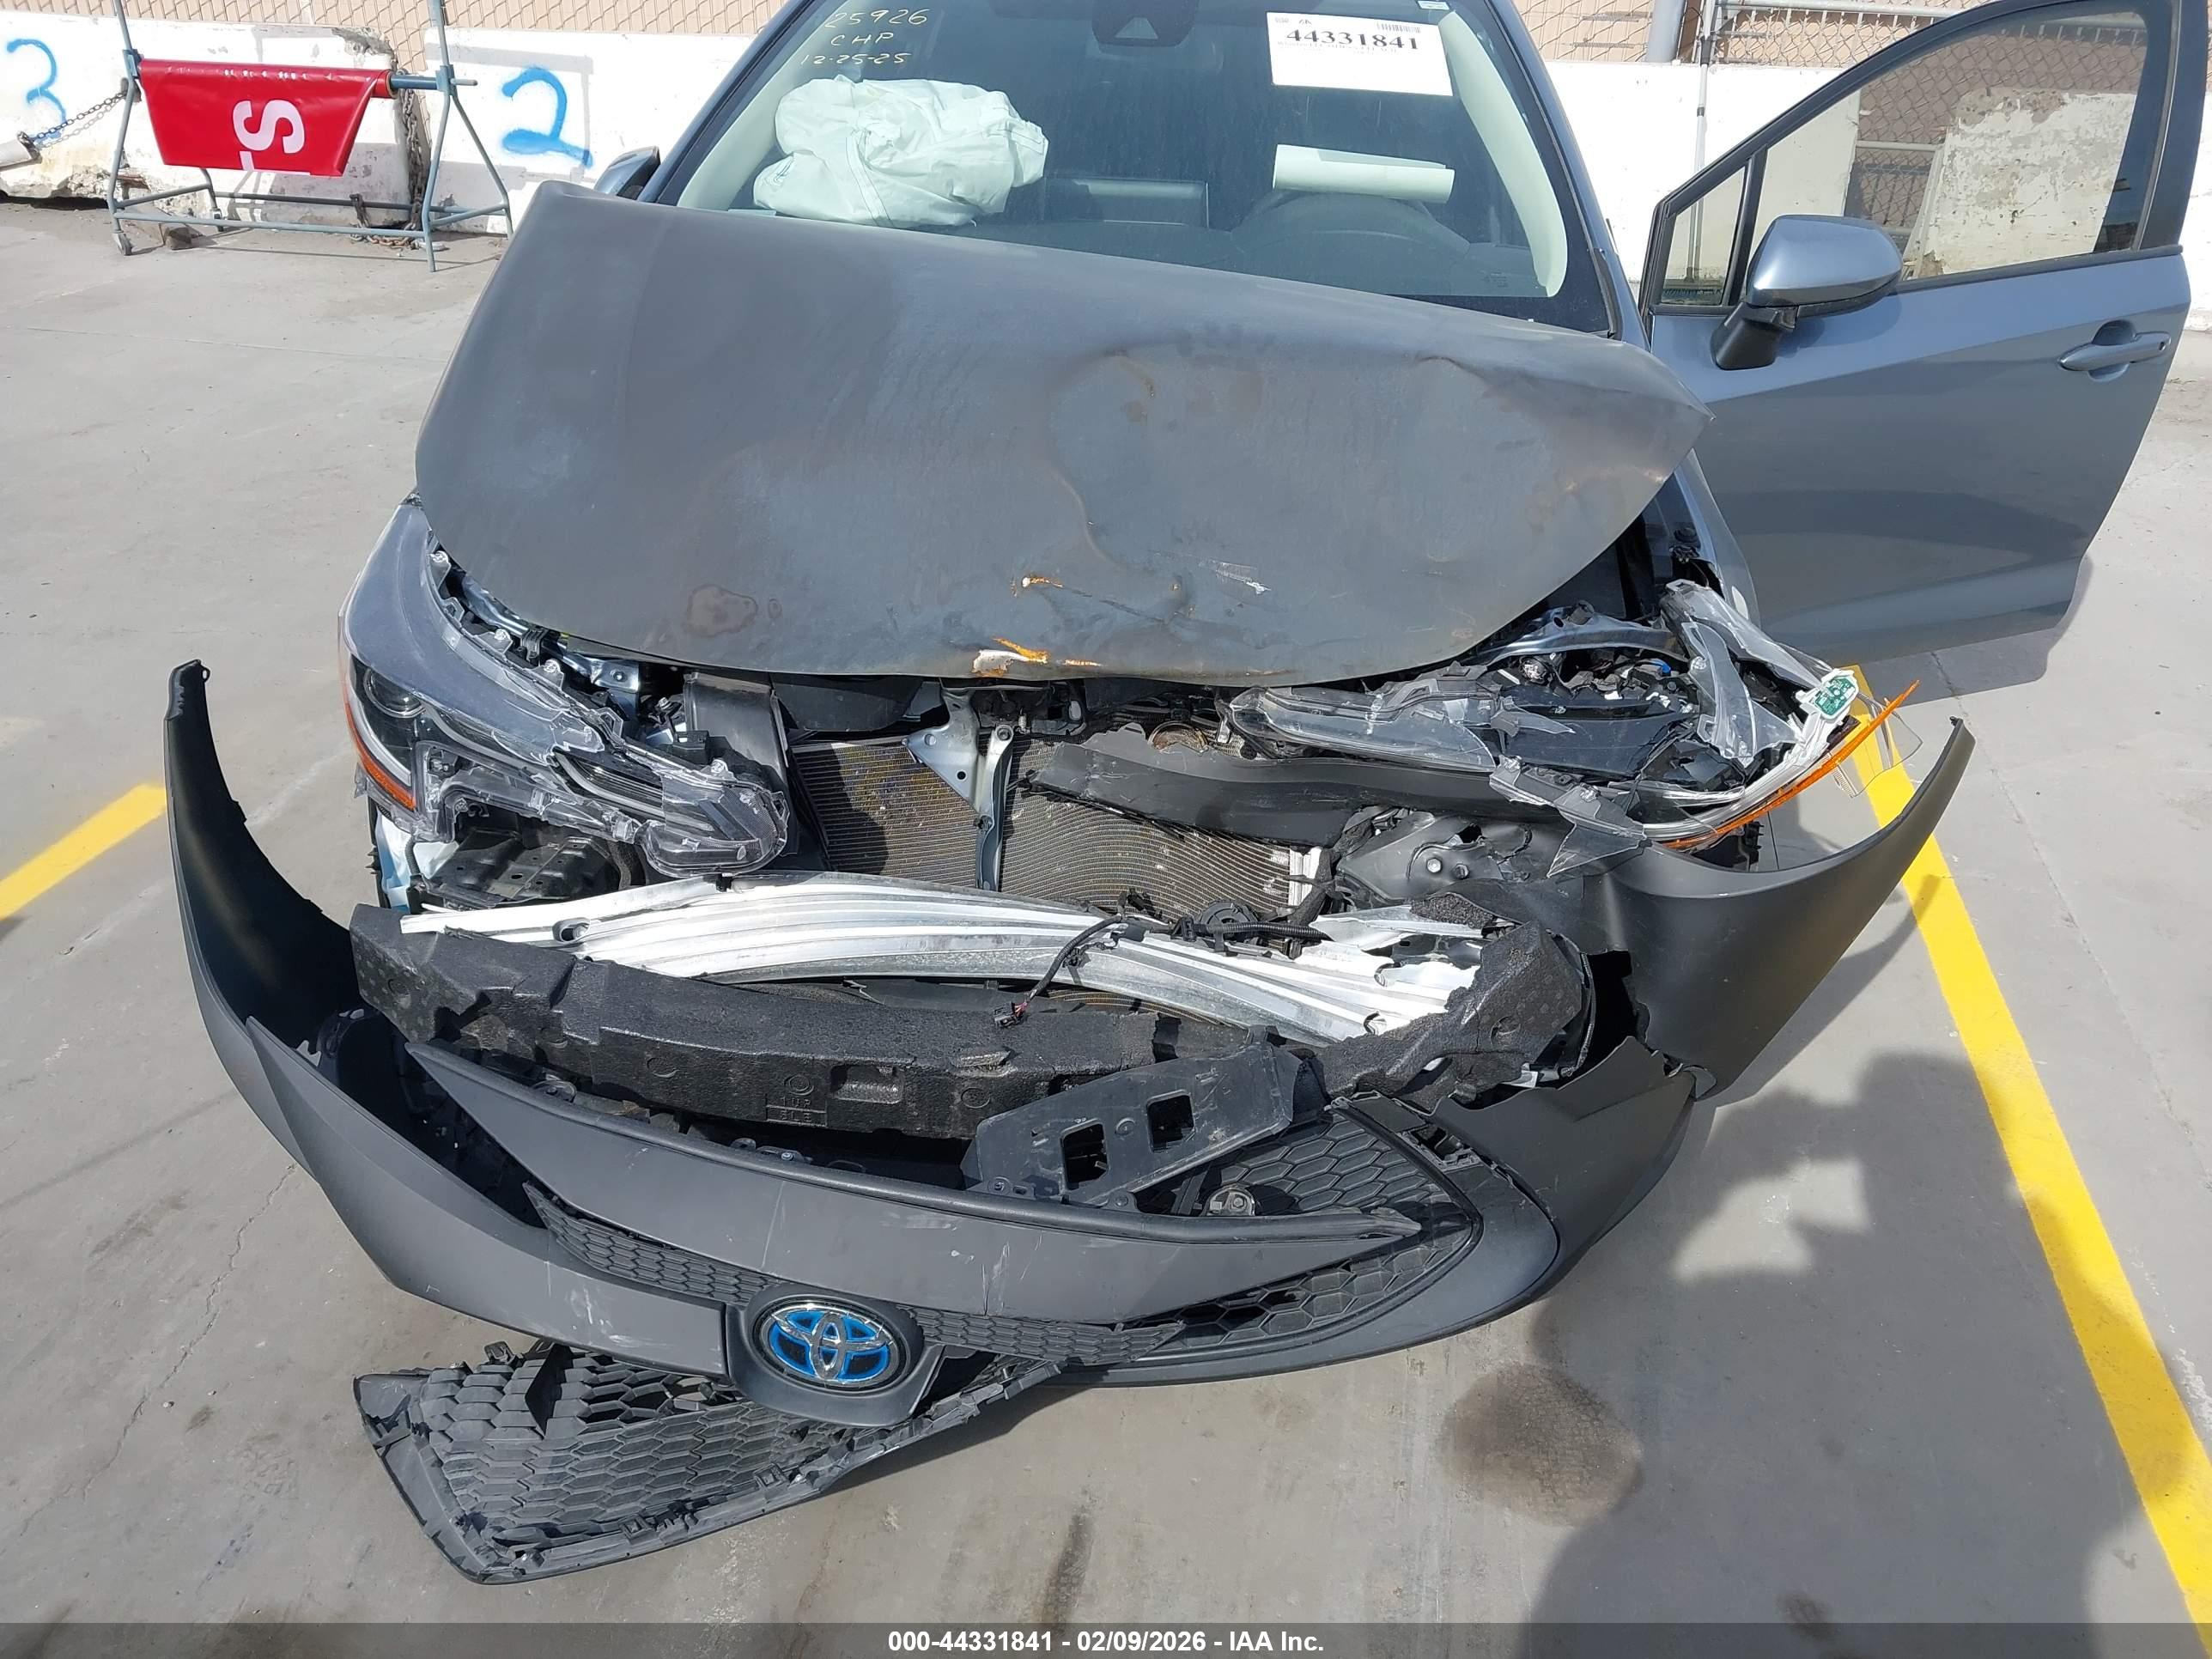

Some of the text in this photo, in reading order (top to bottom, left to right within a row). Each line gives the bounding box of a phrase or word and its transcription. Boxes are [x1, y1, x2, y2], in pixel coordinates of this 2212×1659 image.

[824, 9, 930, 28] 25926
[830, 32, 894, 46] CHP
[1286, 28, 1419, 50] 44331841
[6, 39, 67, 150] 3
[501, 66, 592, 168] 2
